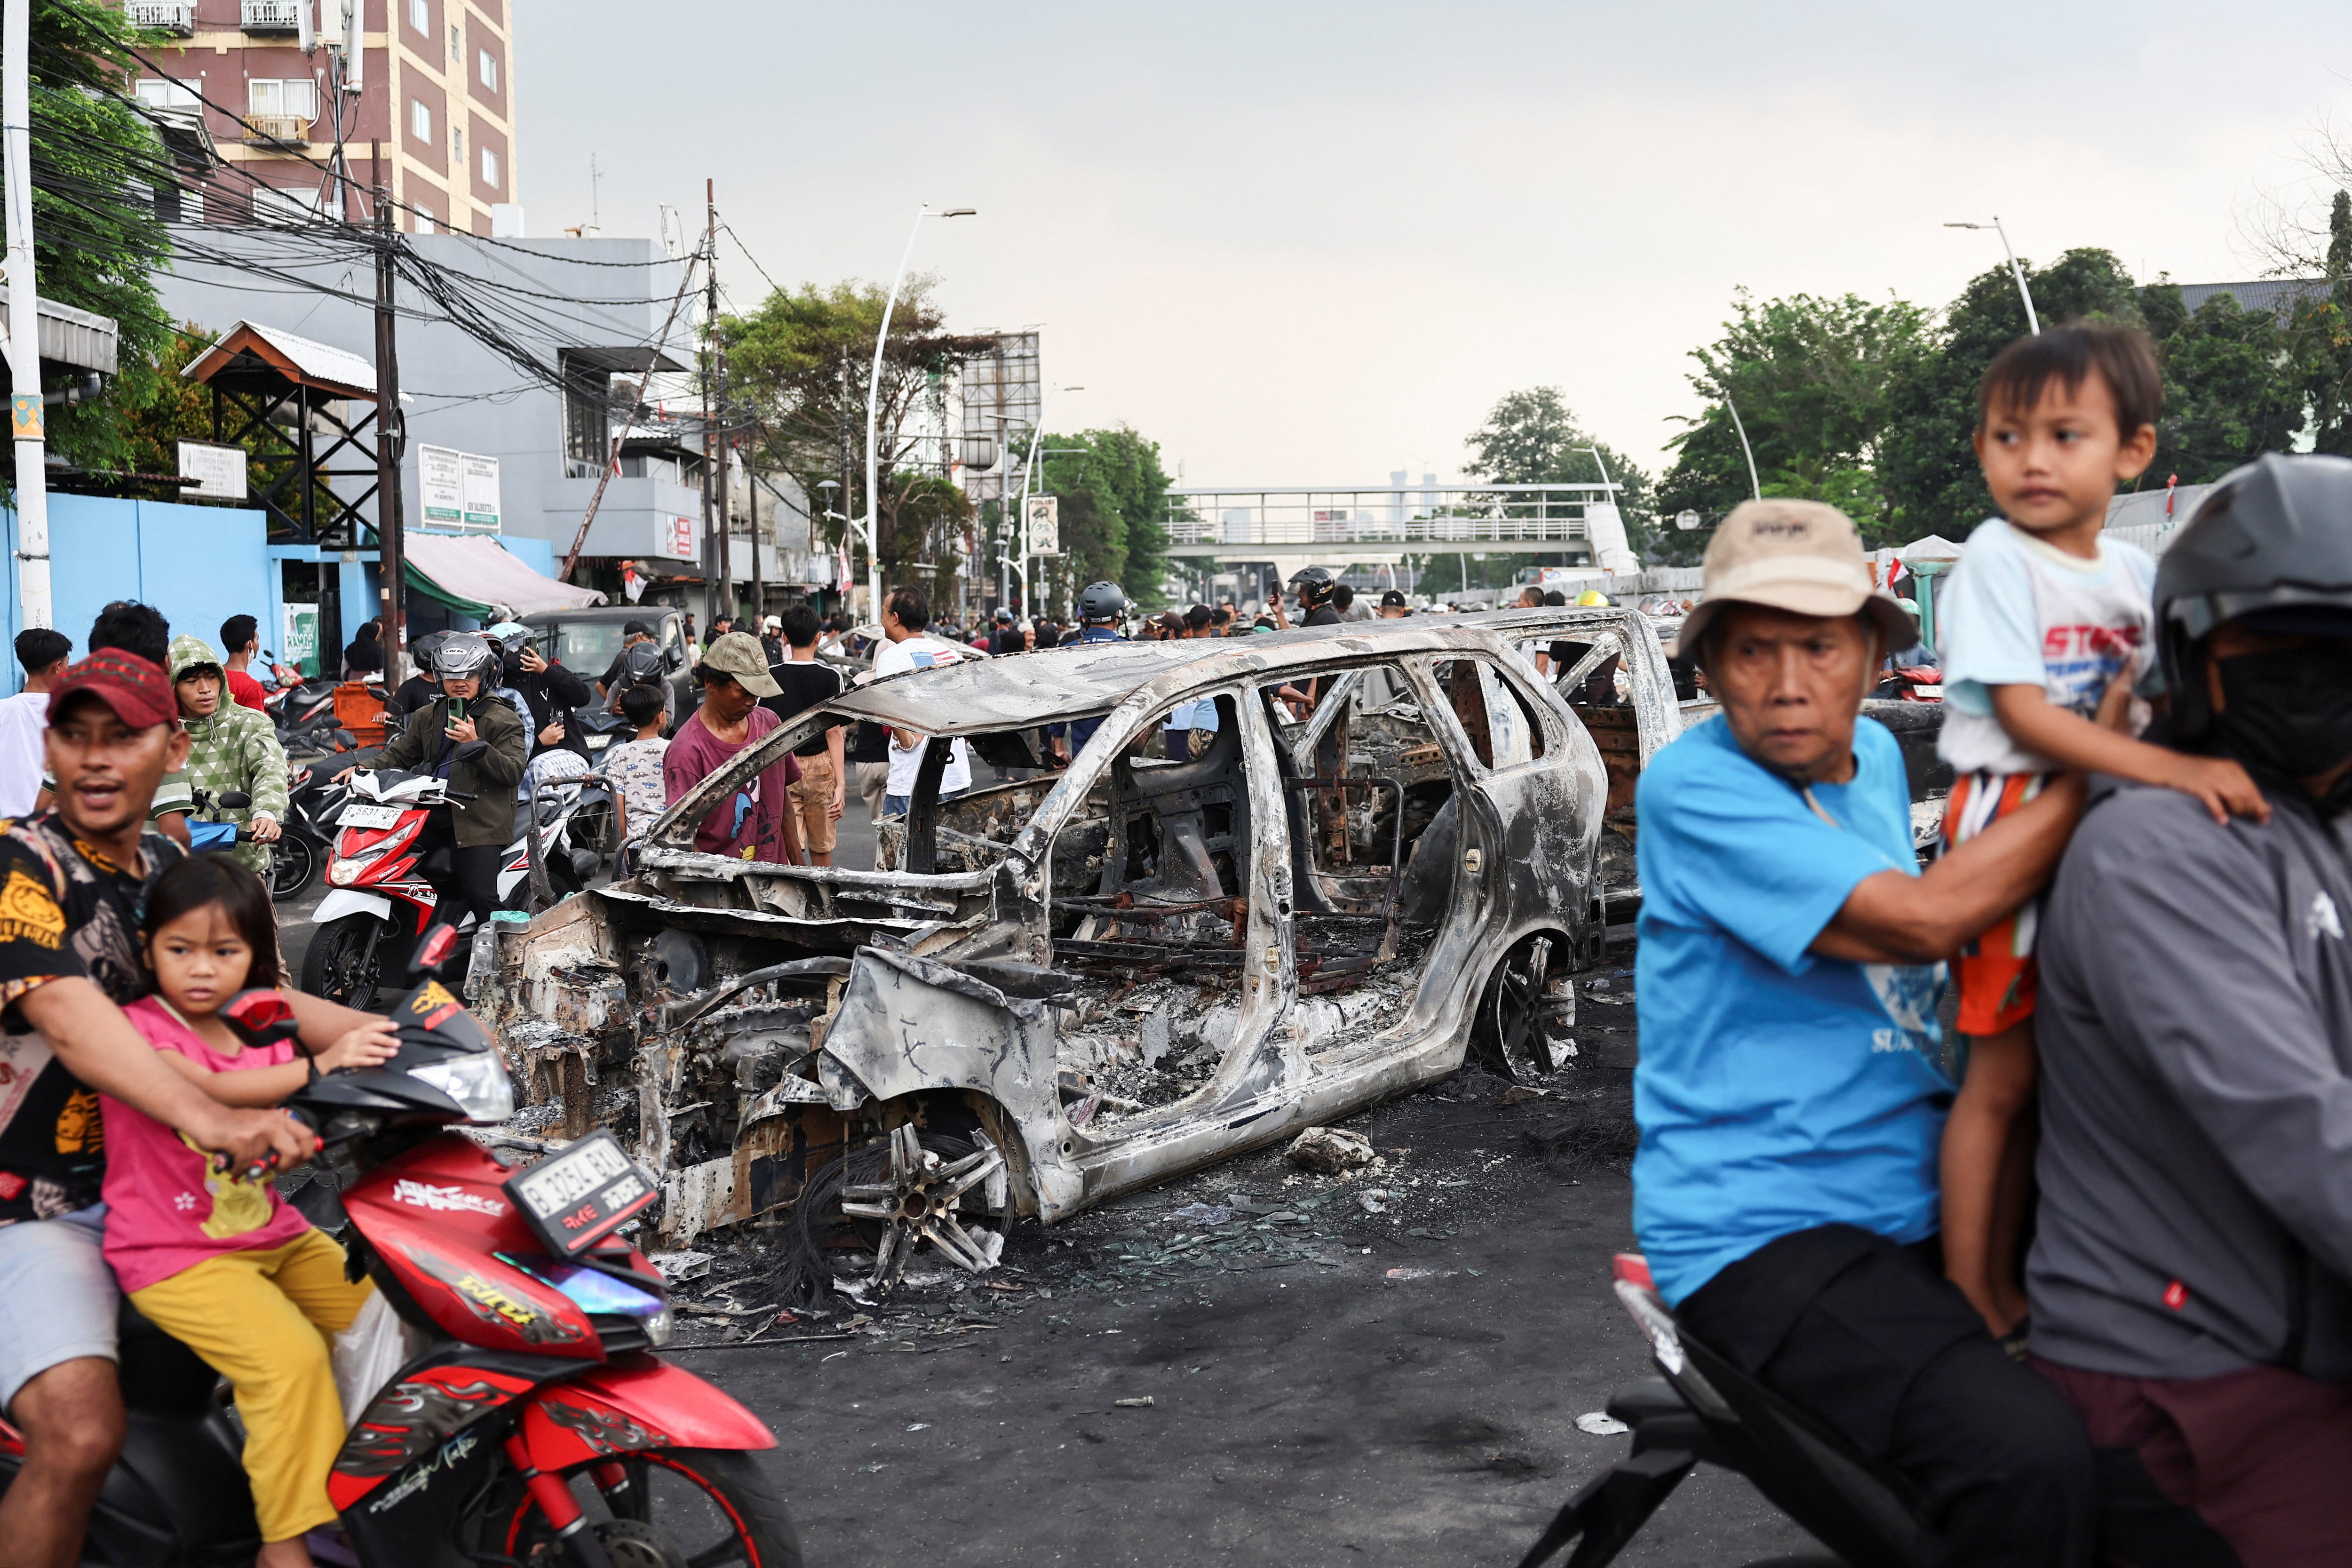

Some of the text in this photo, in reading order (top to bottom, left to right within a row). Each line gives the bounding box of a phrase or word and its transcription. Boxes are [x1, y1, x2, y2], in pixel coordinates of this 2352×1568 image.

[356, 807, 379, 816] 5631
[381, 809, 400, 818] JCF
[378, 865, 400, 879] HONDA
[527, 1187, 550, 1213] B
